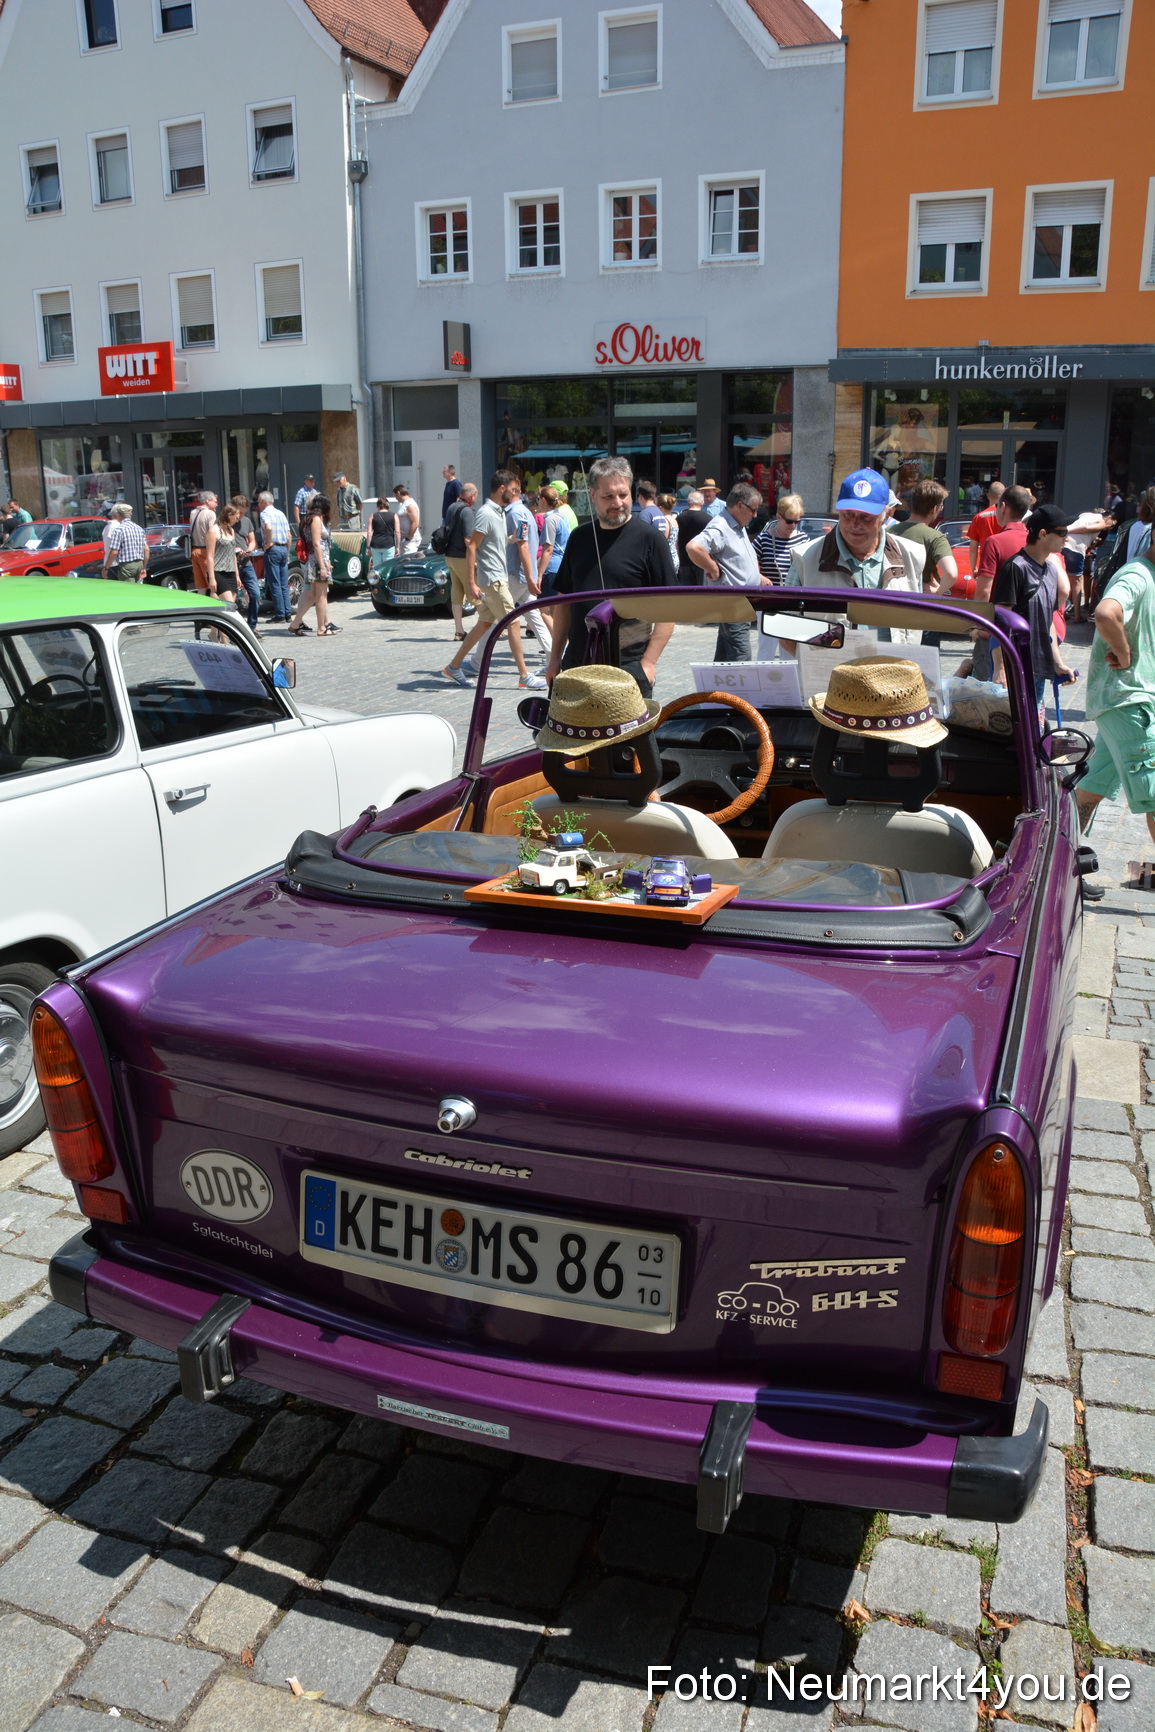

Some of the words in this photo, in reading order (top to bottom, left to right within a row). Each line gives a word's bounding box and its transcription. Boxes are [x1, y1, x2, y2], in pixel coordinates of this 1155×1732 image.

[595, 322, 704, 365] s.Oliver
[106, 352, 158, 379] WITT
[935, 355, 1083, 379] hunkemöller
[123, 377, 150, 387] weiden
[404, 1149, 533, 1180] Cabriolet
[191, 1165, 259, 1209] DDR
[315, 1220, 325, 1236] D
[339, 1190, 433, 1265] KEH
[471, 1217, 538, 1284] MS
[556, 1233, 624, 1299] 86
[638, 1245, 663, 1263] 03
[750, 1257, 906, 1279] Trabant
[637, 1287, 661, 1305] 10
[715, 1309, 738, 1322] KFZ
[749, 1314, 798, 1329] SERVICE
